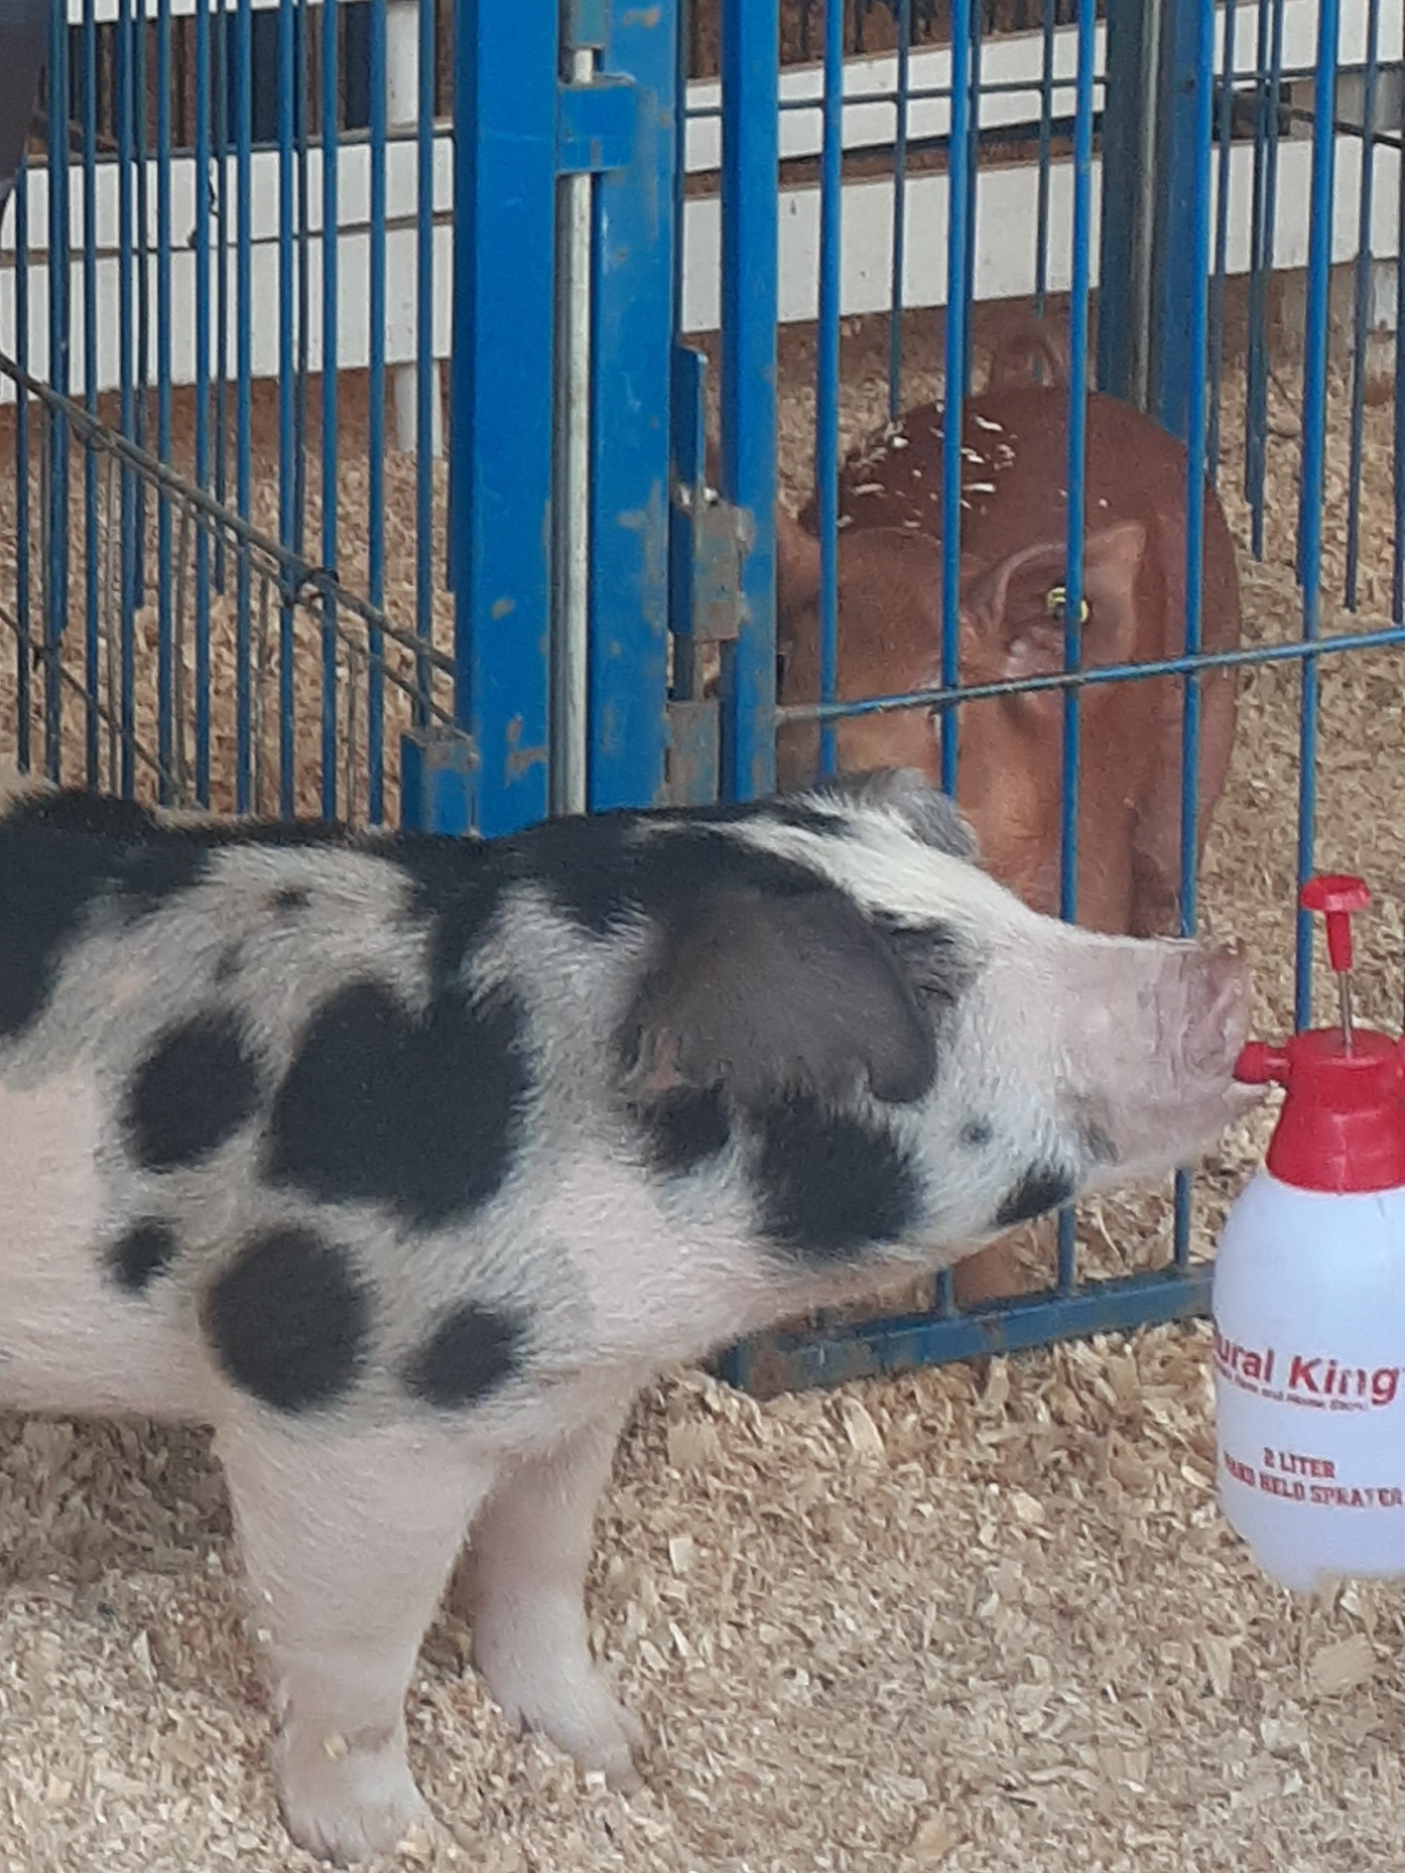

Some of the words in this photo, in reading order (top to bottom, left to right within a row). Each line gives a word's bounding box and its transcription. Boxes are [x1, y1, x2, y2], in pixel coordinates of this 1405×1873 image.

[1288, 1355, 1400, 1406] King
[1263, 1446, 1275, 1469] 2
[1279, 1452, 1336, 1479] LITER
[1259, 1472, 1306, 1502] HELD
[1309, 1484, 1404, 1509] SPRAYER
